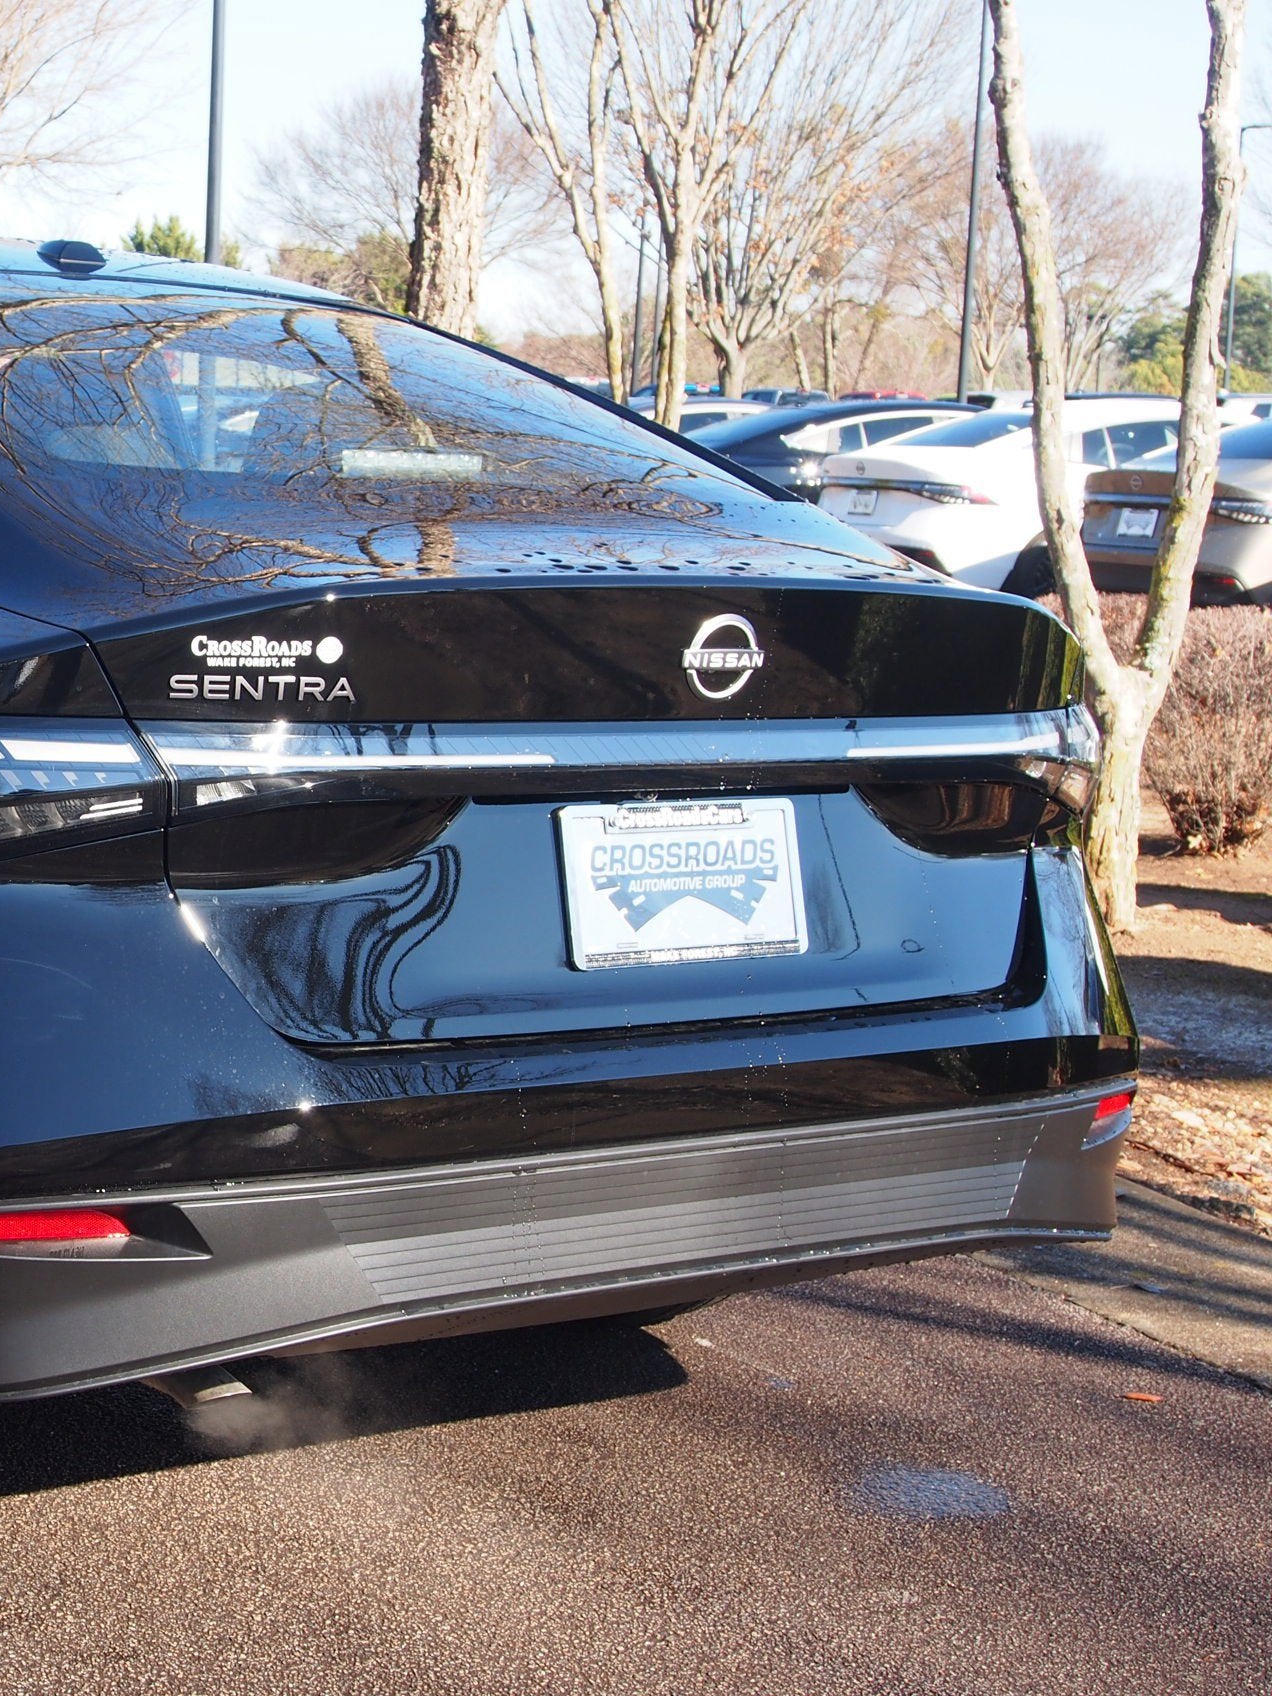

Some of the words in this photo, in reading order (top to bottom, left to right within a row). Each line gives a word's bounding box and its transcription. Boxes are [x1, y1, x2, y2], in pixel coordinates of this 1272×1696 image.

[207, 657, 237, 667] WAKE
[239, 657, 280, 669] FOREST,
[282, 657, 296, 667] NC
[684, 652, 765, 669] NISSAN
[169, 674, 356, 702] SENTRA
[590, 838, 776, 873] CROSSROADS
[628, 875, 704, 894] AUTOMOTIVE
[705, 874, 746, 890] GROUP
